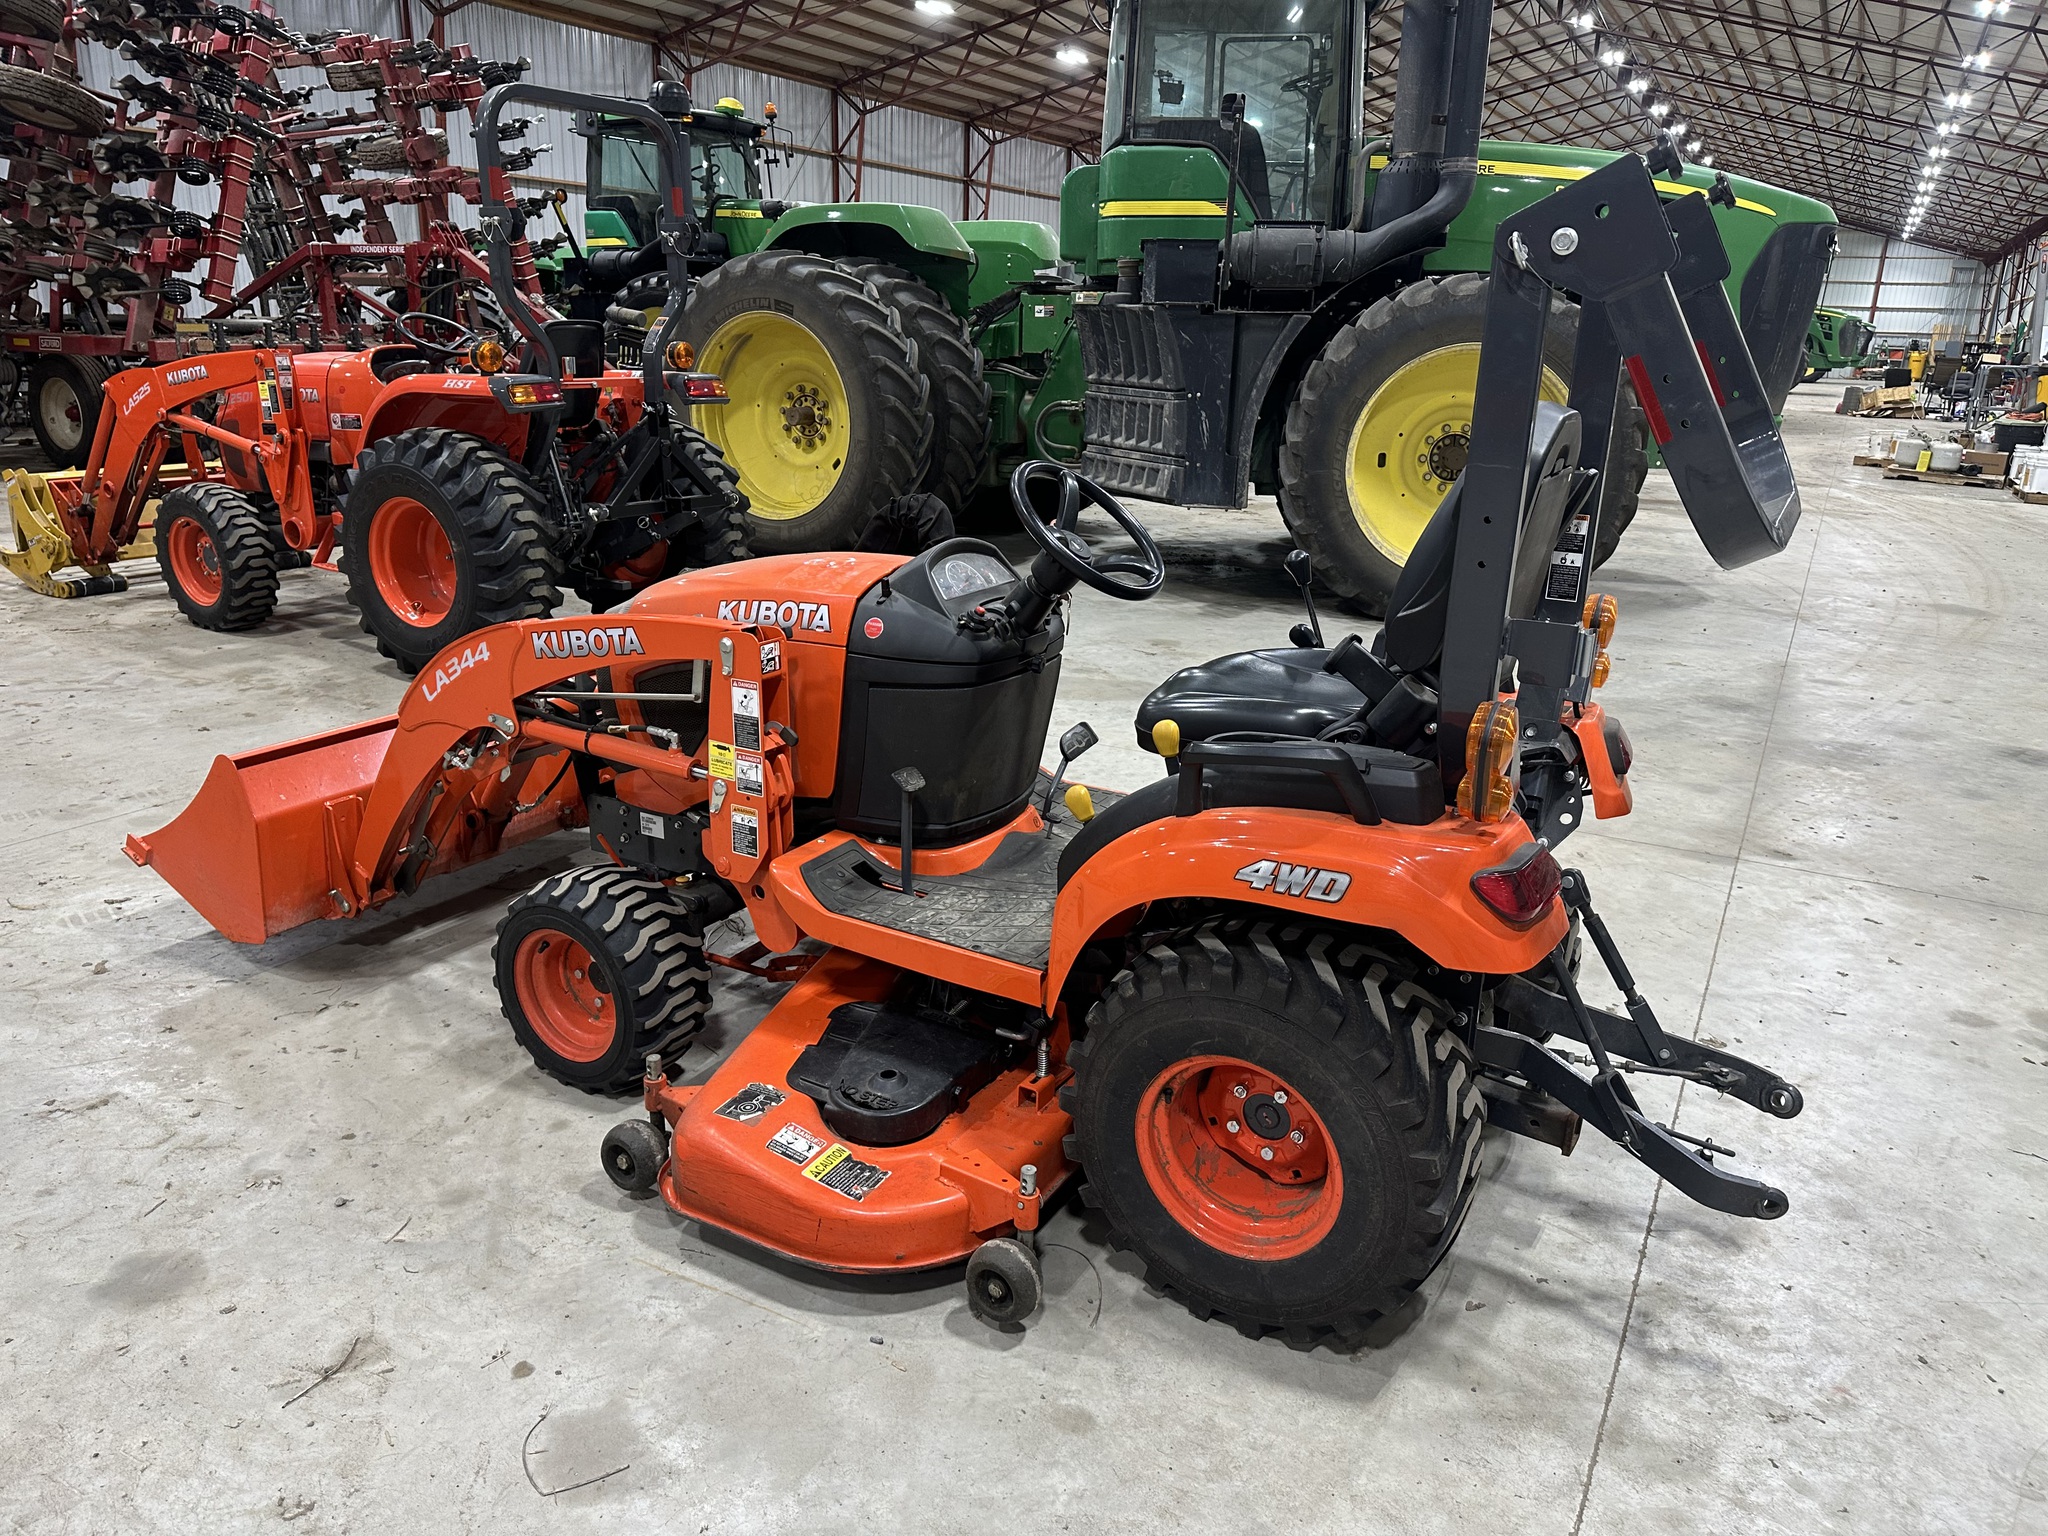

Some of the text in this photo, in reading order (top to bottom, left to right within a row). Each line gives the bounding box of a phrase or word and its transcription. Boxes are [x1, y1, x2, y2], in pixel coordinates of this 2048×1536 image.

[350, 245, 388, 254] INDEPENDENT
[714, 297, 771, 323] MICHELIN
[166, 364, 210, 387] KUBOTA
[442, 378, 477, 389] HST
[123, 381, 151, 416] LA525
[717, 599, 831, 633] KUBOTA
[531, 625, 645, 660] KUBOTA
[421, 641, 490, 702] LA344
[737, 681, 757, 690] DANGER
[711, 757, 732, 767] LUBRICATE
[742, 754, 761, 764] DANGER
[736, 807, 756, 817] WARNING
[1234, 859, 1353, 903] 4WD
[835, 1078, 900, 1110] NO STEP
[793, 1127, 824, 1147] DANGER
[815, 1146, 847, 1172] CAUTION
